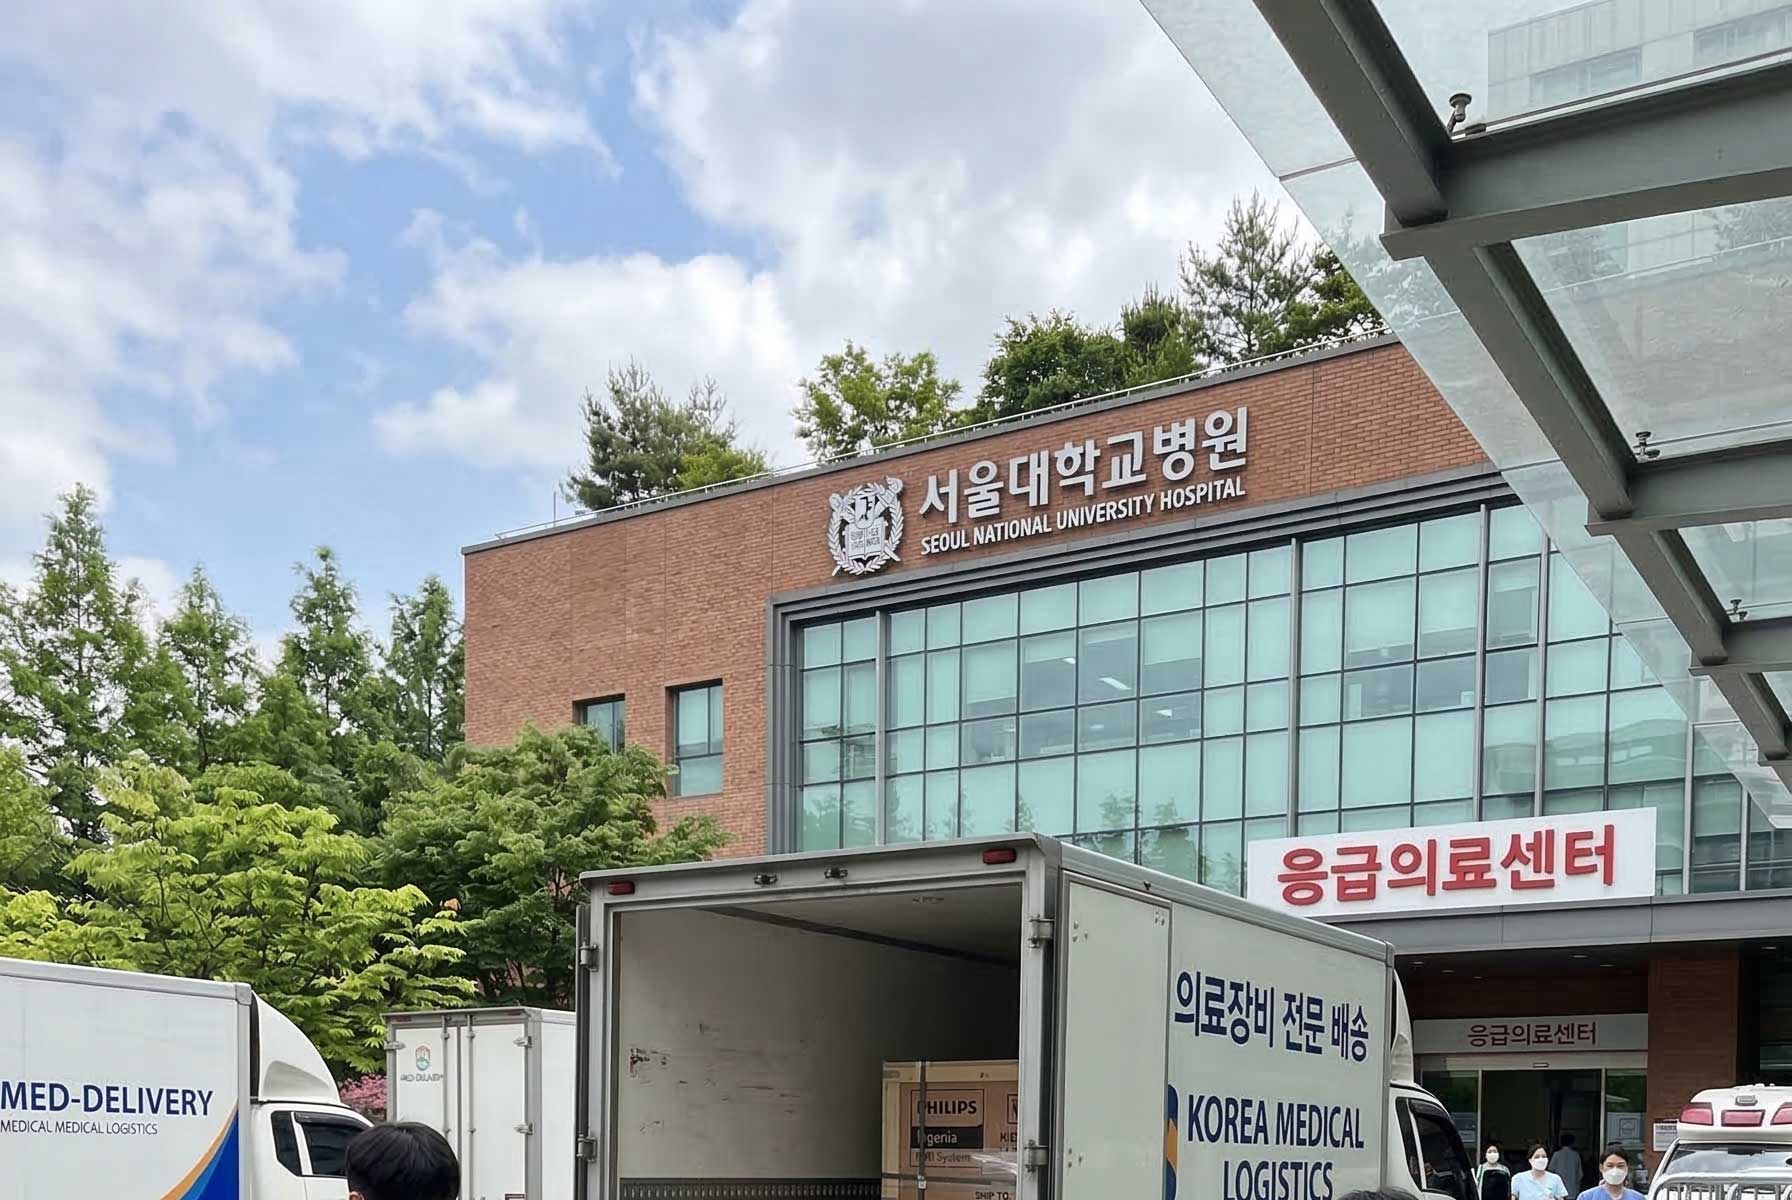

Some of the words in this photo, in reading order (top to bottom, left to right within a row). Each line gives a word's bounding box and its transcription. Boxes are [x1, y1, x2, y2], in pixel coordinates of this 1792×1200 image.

[918, 406, 1248, 523] 서울대학교병원
[920, 527, 970, 556] SEOUL
[972, 515, 1052, 546] NATIONAL
[1056, 494, 1155, 530] UNIVERSITY
[1160, 476, 1246, 510] HOSPITAL
[1277, 824, 1615, 906] 응급의료센터
[1174, 970, 1274, 1048] 의료장비
[1282, 991, 1325, 1055] 전문
[1330, 1002, 1369, 1063] 배송
[1467, 1021, 1597, 1047] 응급의료센터
[0, 1120, 53, 1133] MEDICAL
[54, 1121, 104, 1134] MEDICAL
[106, 1122, 158, 1135] LOGISTICS
[1, 1081, 213, 1116] MED-DELIVERY
[1187, 1093, 1269, 1145] KOREA
[1275, 1101, 1365, 1149] MEDICAL
